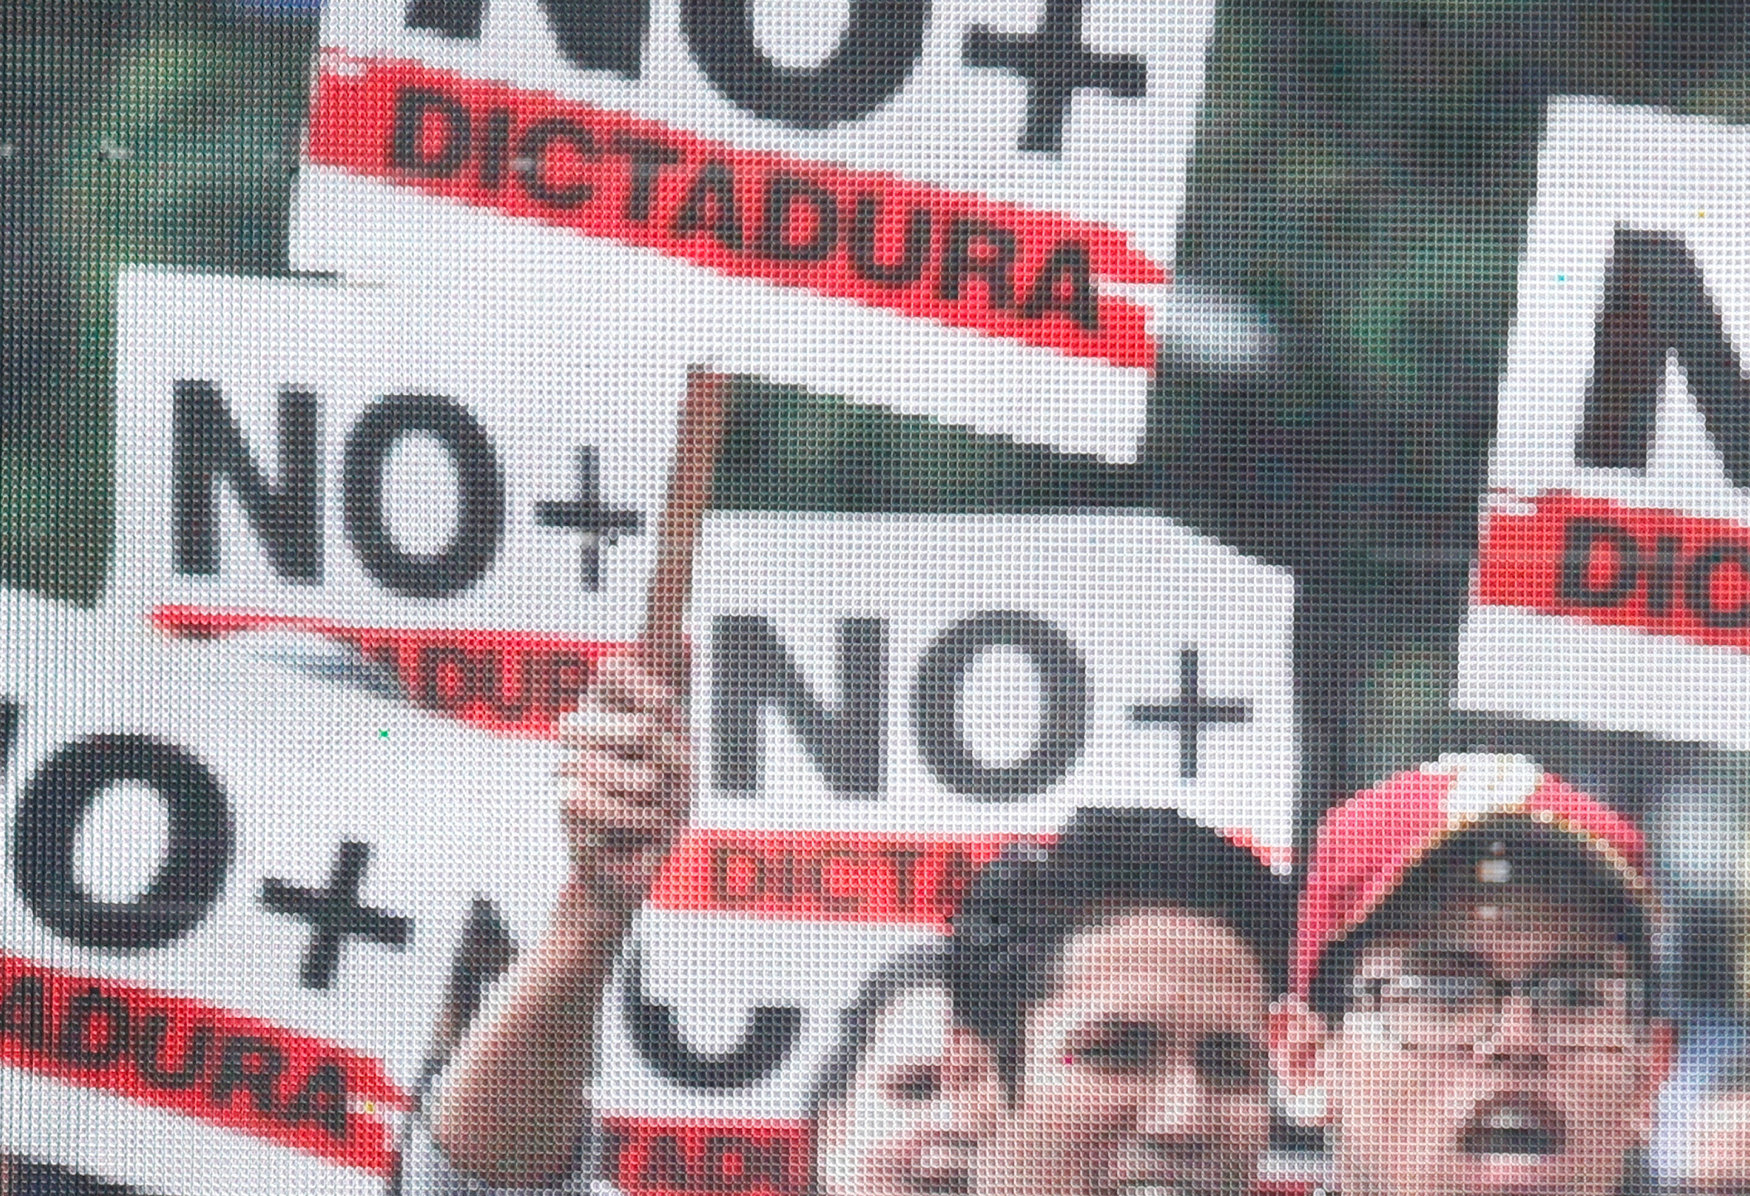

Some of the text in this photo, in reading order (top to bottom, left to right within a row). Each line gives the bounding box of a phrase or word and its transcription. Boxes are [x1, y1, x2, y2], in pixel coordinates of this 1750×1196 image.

[391, 87, 1101, 331] DICTADURA
[172, 377, 642, 601] NO+
[711, 614, 1247, 798] NO+
[0, 702, 414, 990] O+
[0, 970, 348, 1140] ADURA
